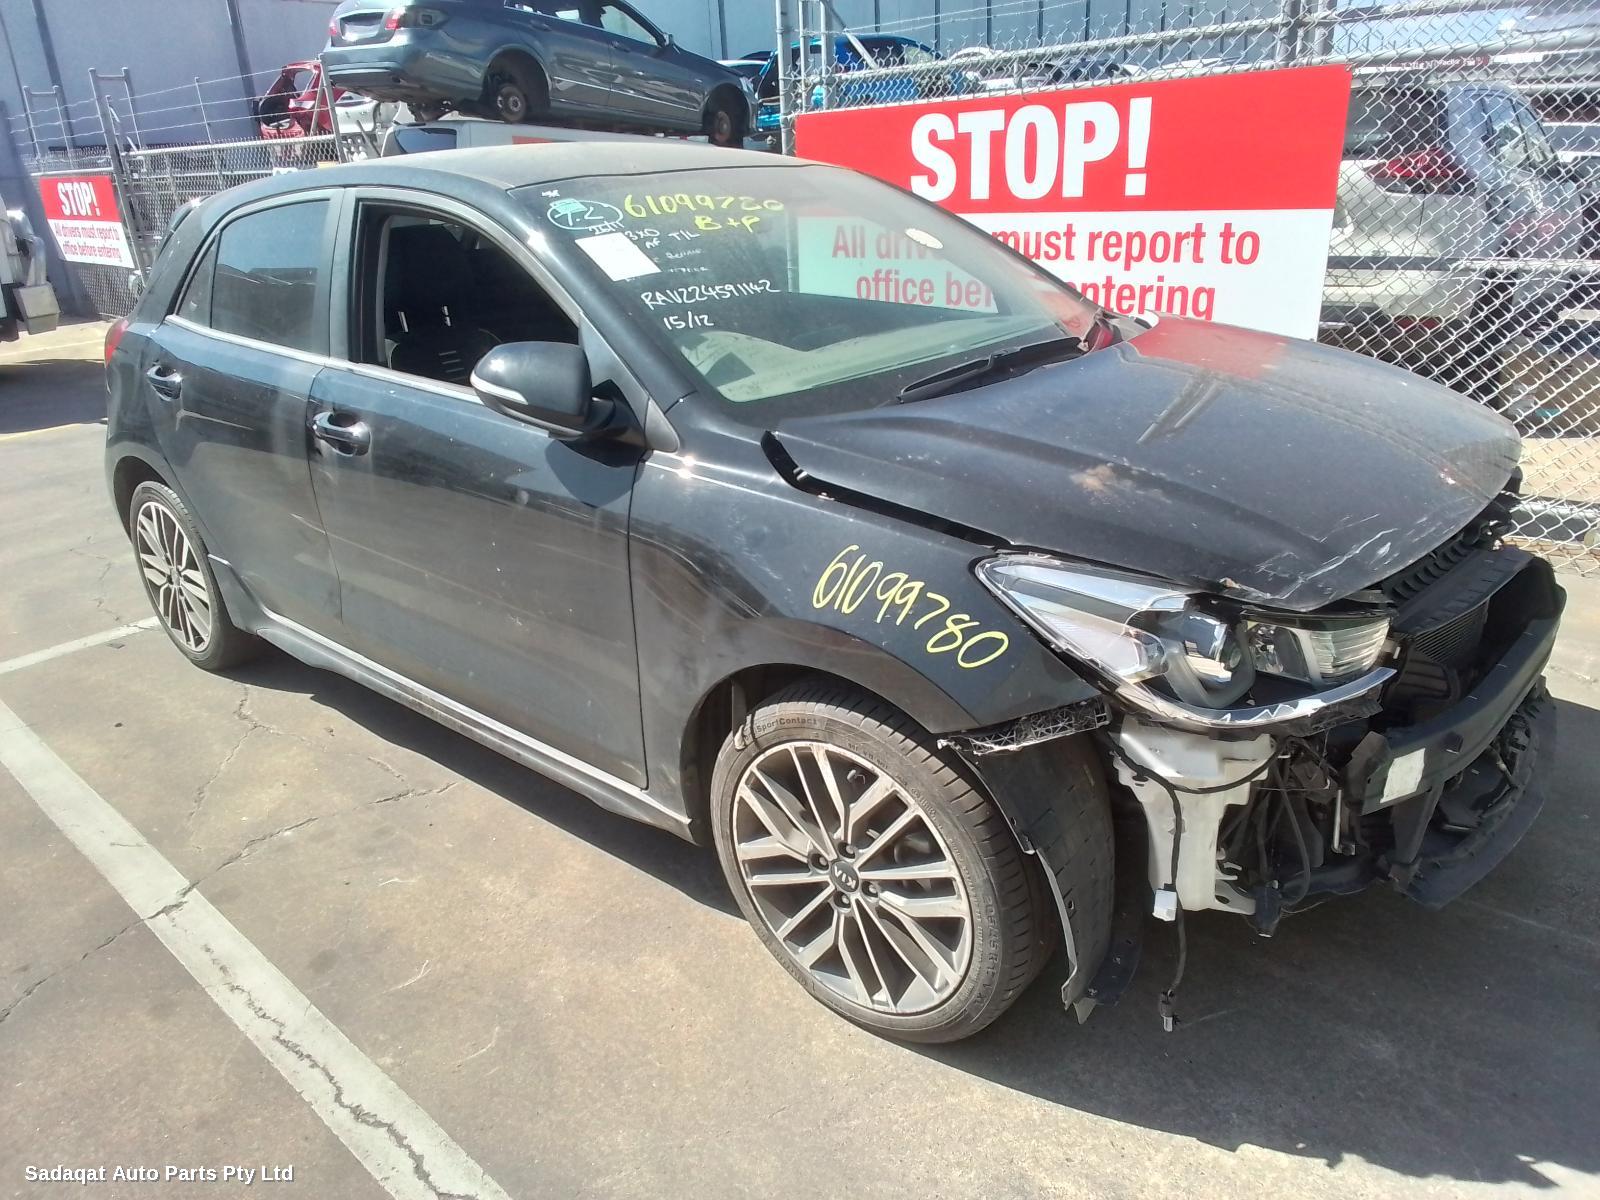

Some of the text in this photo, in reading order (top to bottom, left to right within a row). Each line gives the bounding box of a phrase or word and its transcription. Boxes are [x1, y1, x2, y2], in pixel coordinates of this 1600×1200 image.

[910, 96, 1153, 203] STOP!
[57, 181, 101, 217] STOP!
[81, 223, 97, 239] must
[96, 225, 114, 242] report
[832, 225, 866, 259] All
[992, 223, 1077, 261] must
[1087, 222, 1207, 272] report
[1219, 222, 1261, 265] to
[856, 268, 936, 305] office
[1066, 275, 1215, 321] ntering
[663, 310, 715, 330] 15/12
[812, 544, 1009, 668] 61099780
